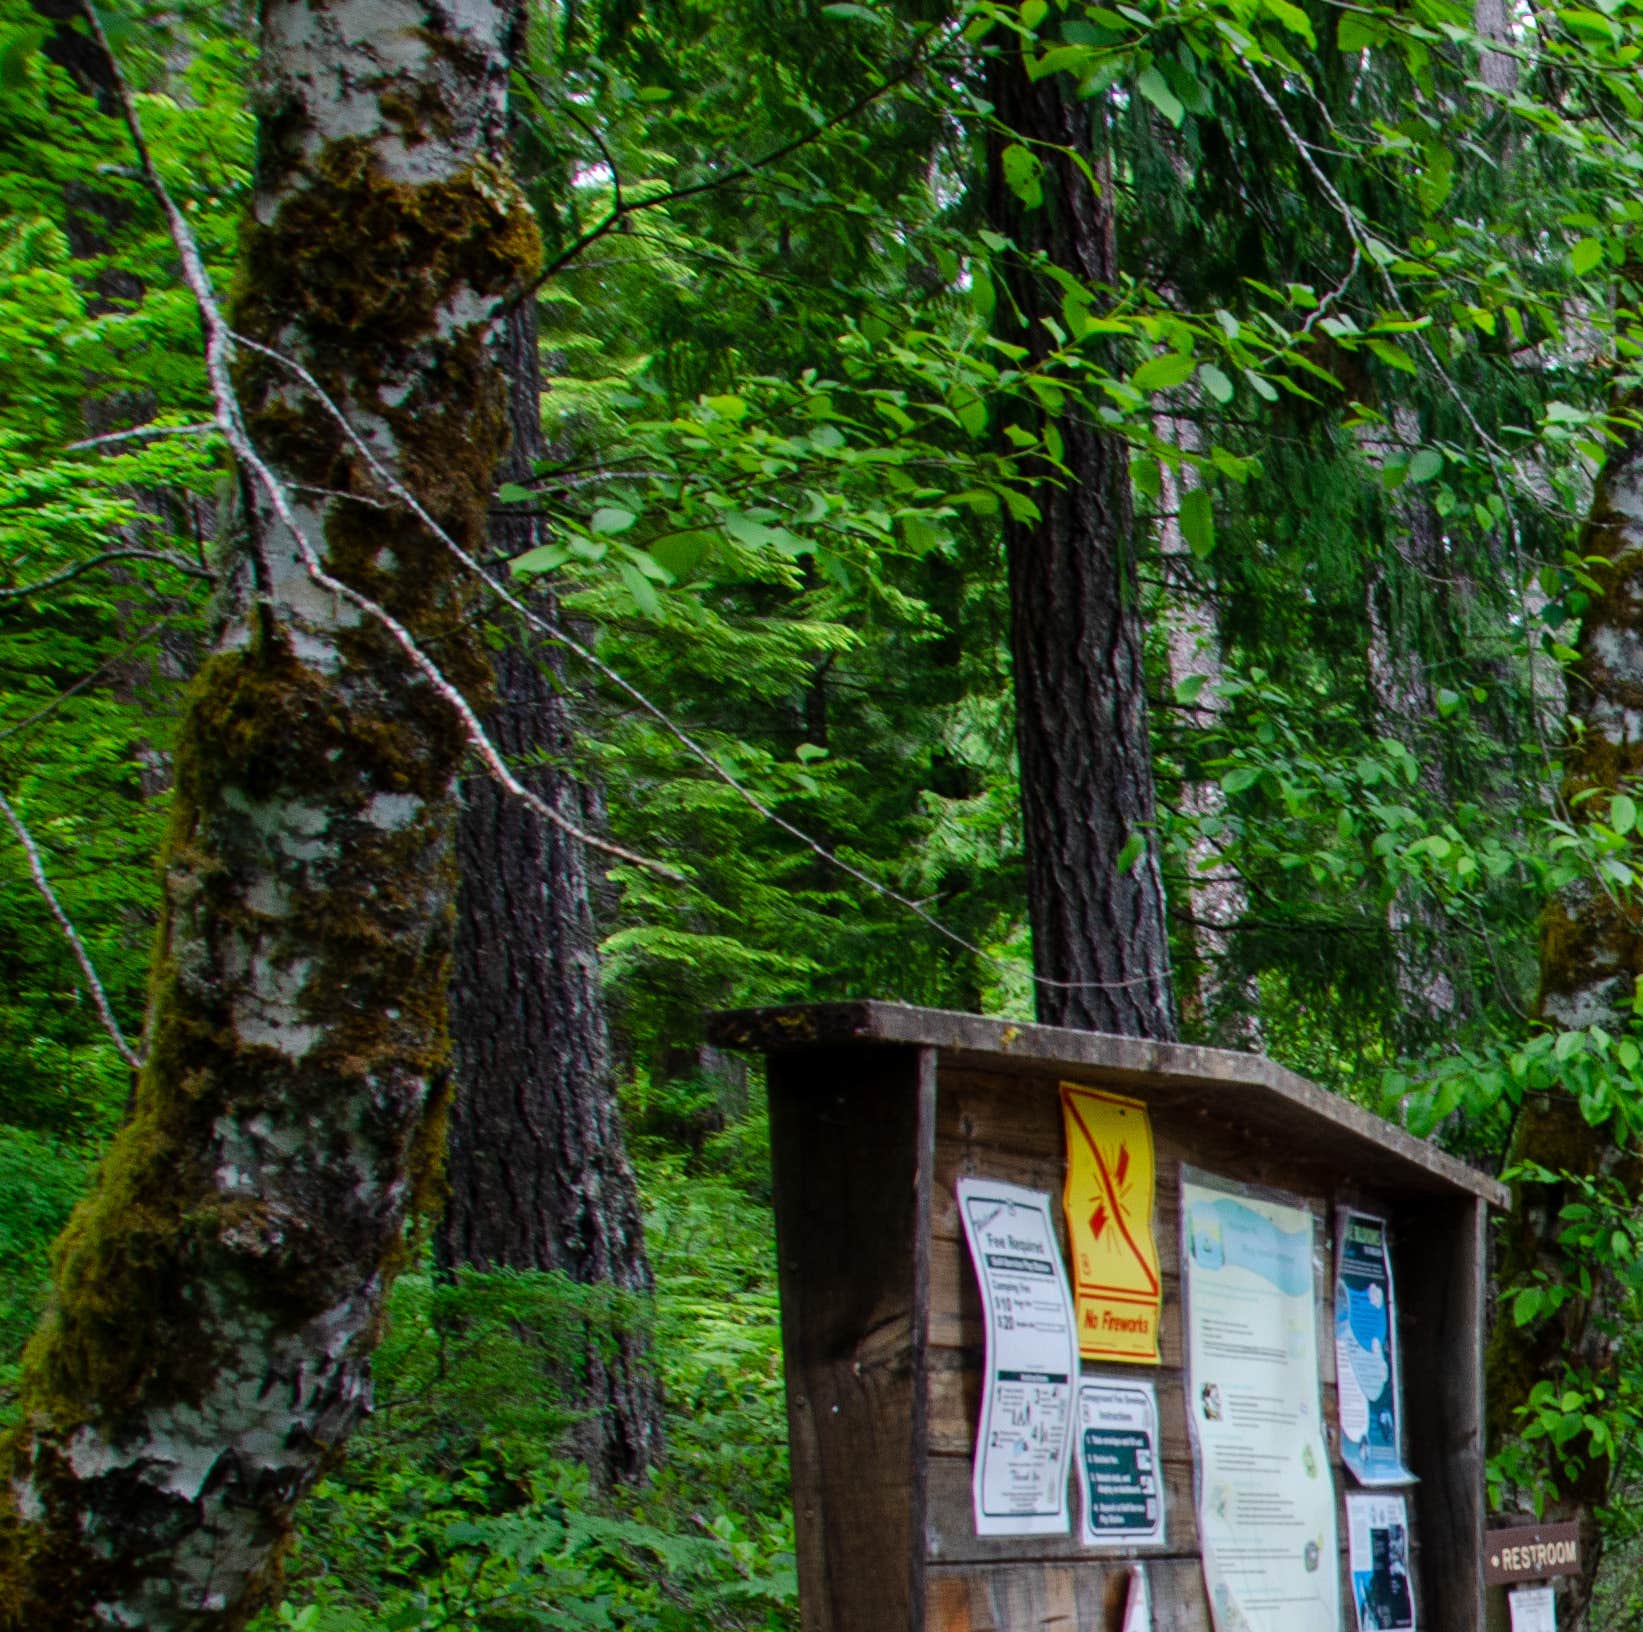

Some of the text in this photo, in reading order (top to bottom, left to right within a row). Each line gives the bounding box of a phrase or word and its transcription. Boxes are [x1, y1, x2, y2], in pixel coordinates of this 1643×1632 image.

[987, 1233, 1005, 1249] Fee
[1085, 1308, 1098, 1328] No
[1102, 1309, 1149, 1335] Fireworks
[1502, 1541, 1577, 1571] RESTROOM
